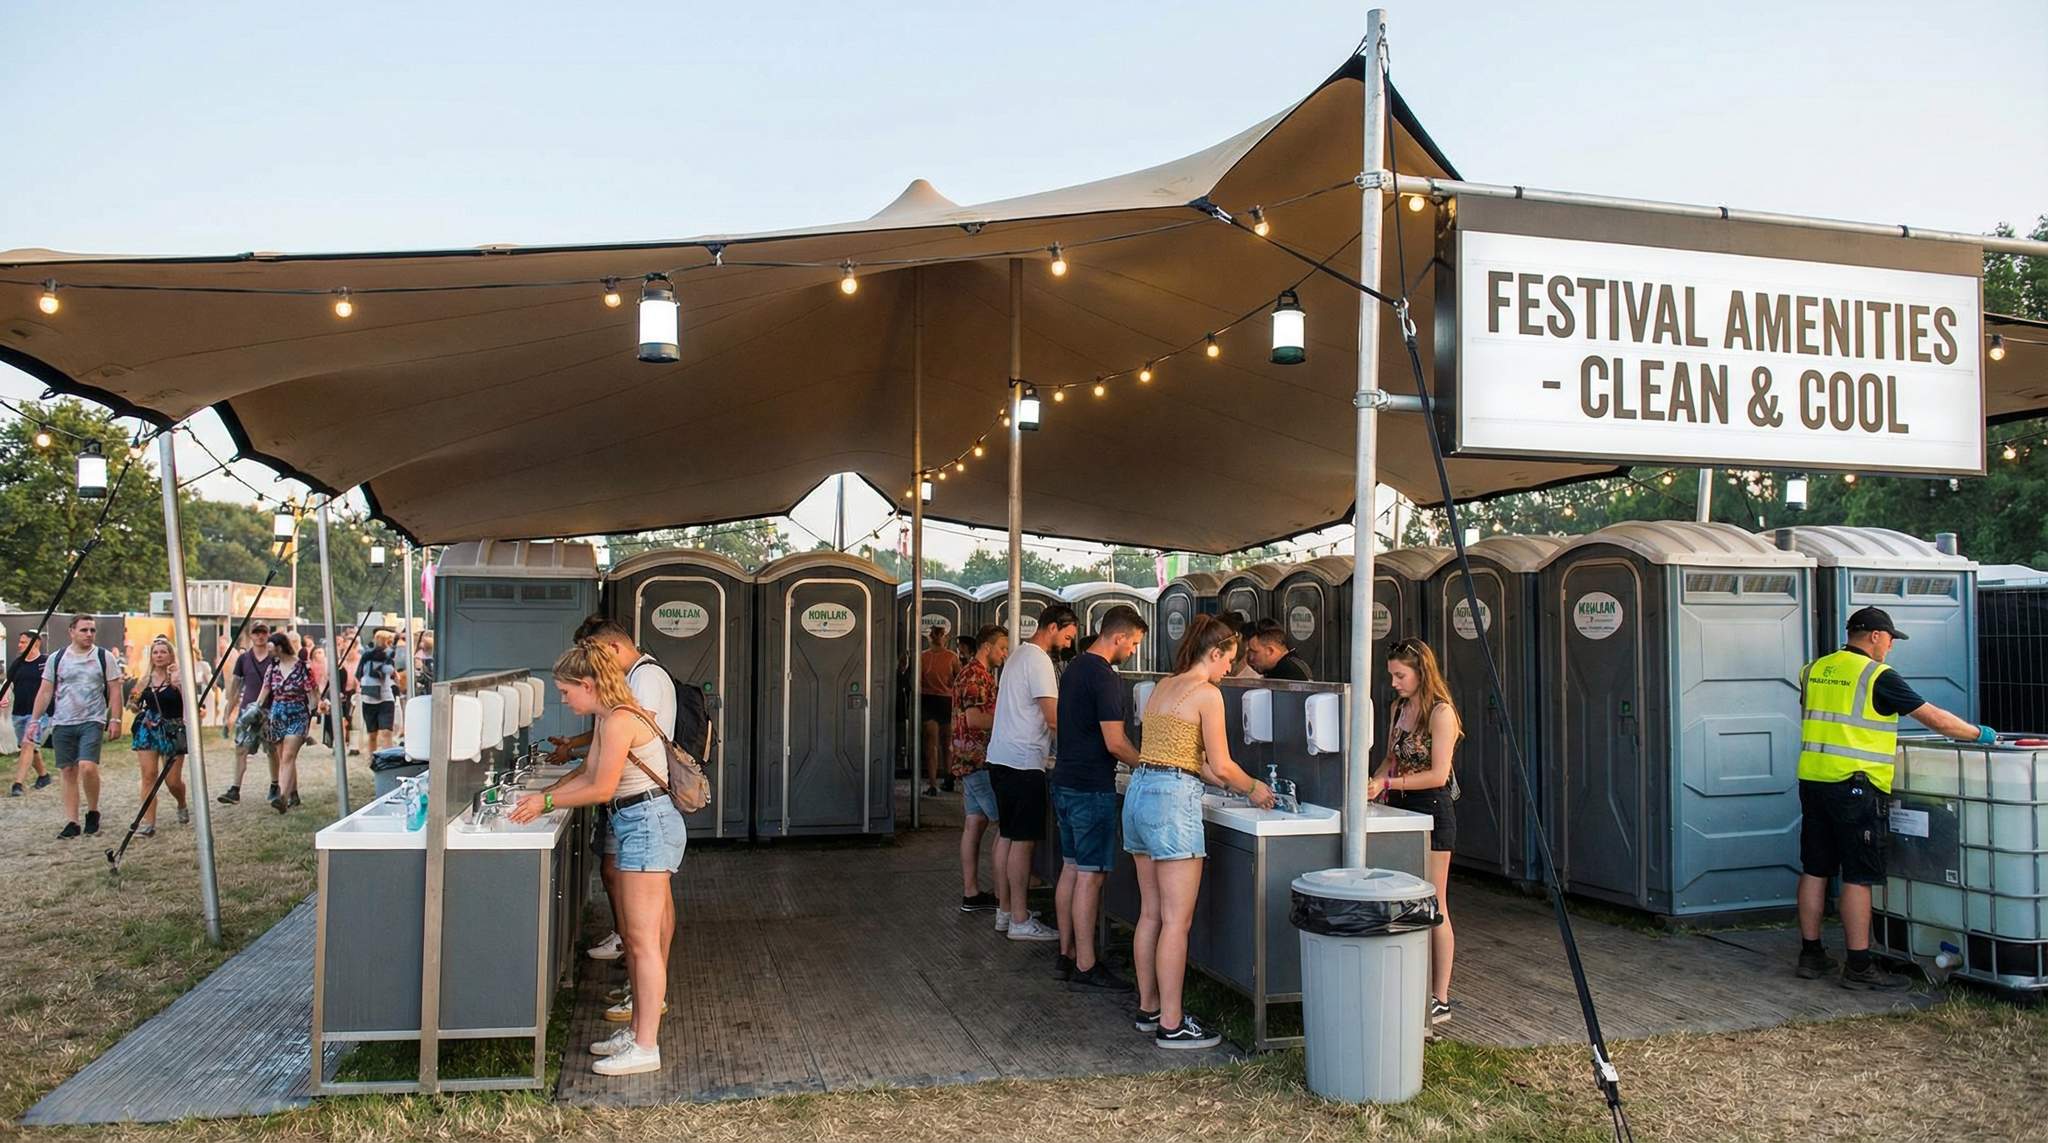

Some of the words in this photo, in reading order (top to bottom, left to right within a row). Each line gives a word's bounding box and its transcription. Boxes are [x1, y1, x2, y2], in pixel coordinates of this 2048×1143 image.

[1488, 270, 1708, 348] FESTIVAL
[1724, 290, 1958, 366] AMENITIES
[1542, 380, 1562, 390] -
[1580, 355, 1729, 425] CLEAN
[1747, 365, 1784, 428] &
[1800, 369, 1909, 434] COOL
